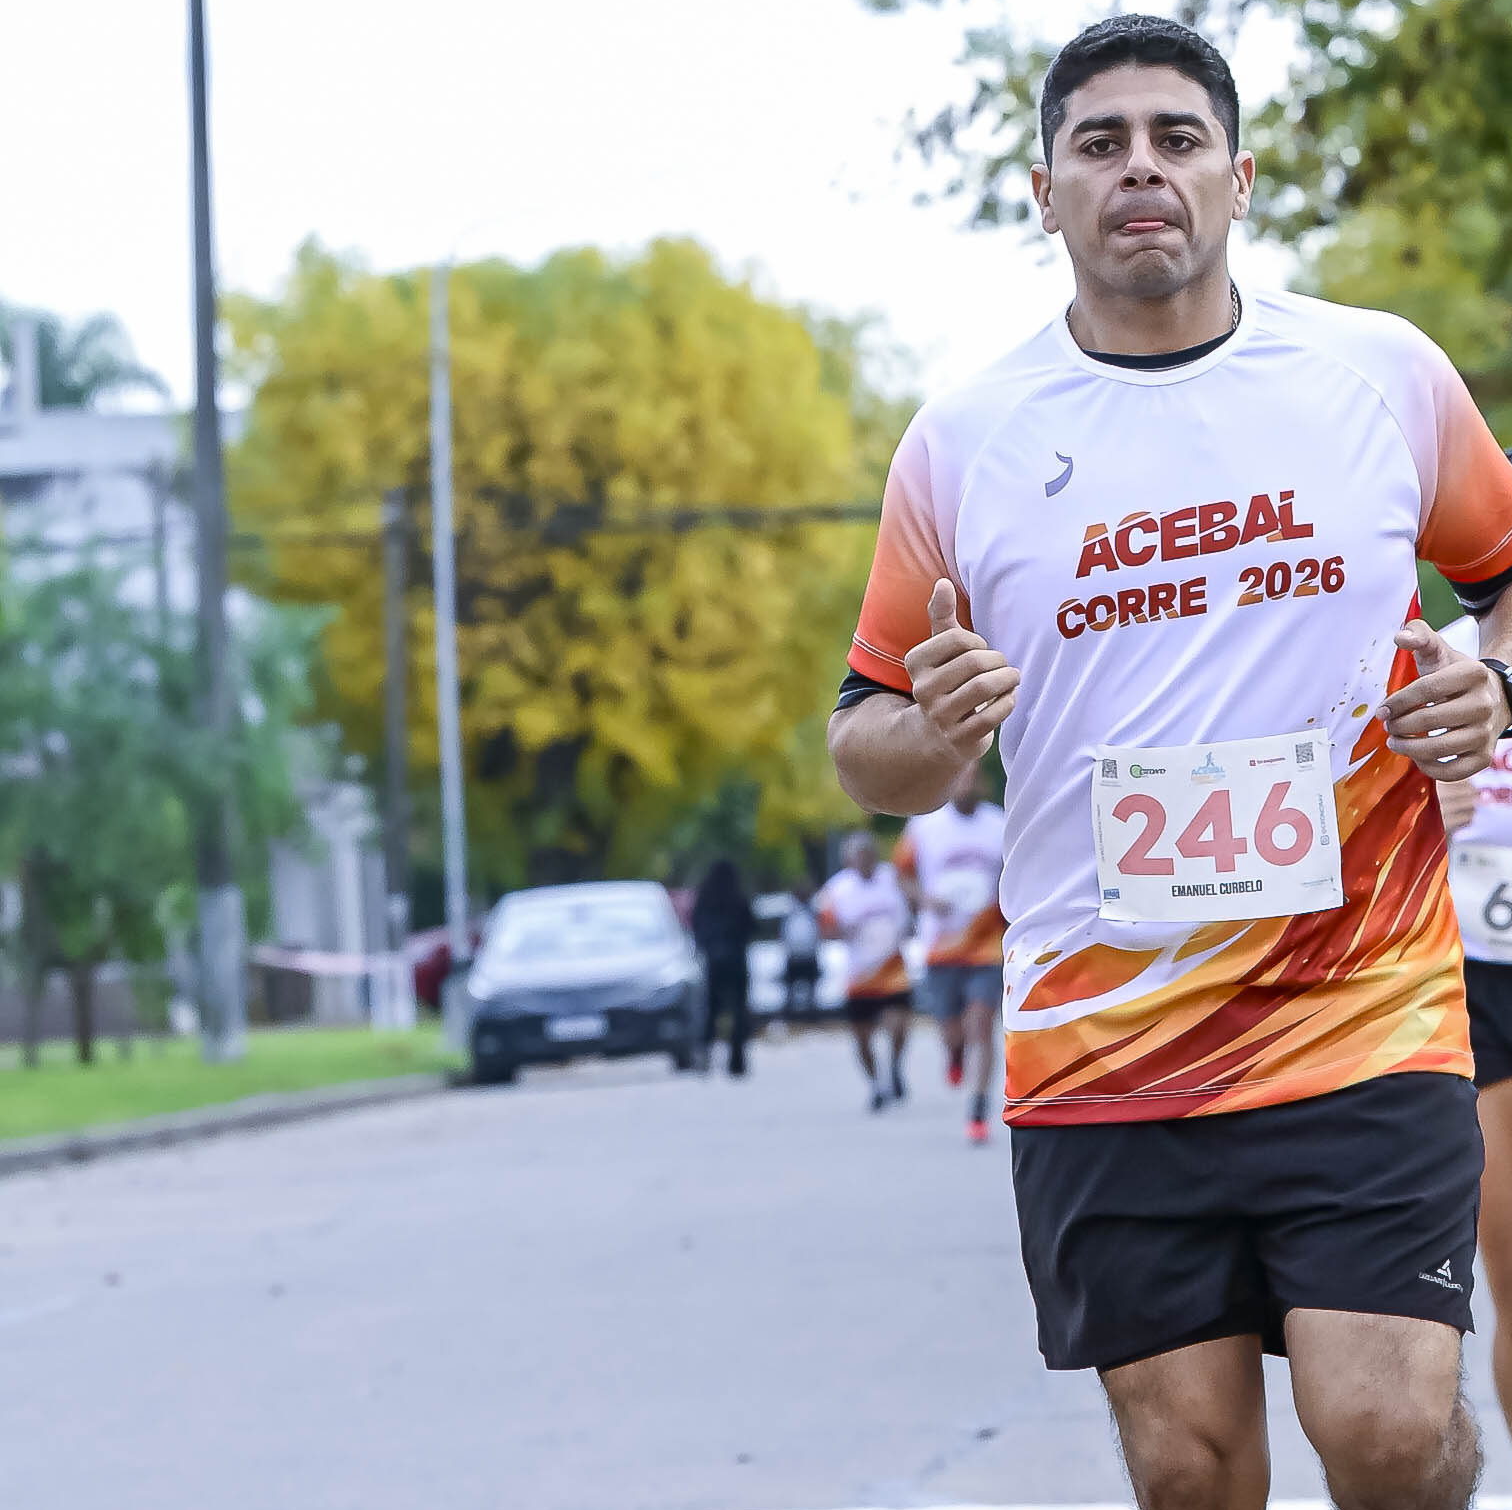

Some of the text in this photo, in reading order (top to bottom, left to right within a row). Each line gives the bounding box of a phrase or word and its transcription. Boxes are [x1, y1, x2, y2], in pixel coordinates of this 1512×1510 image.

[1075, 490, 1314, 579] ACEBAL
[1056, 555, 1345, 640] CORRE 2026
[1111, 781, 1314, 876] 246
[1171, 879, 1263, 897] EMANUEL CURBELO
